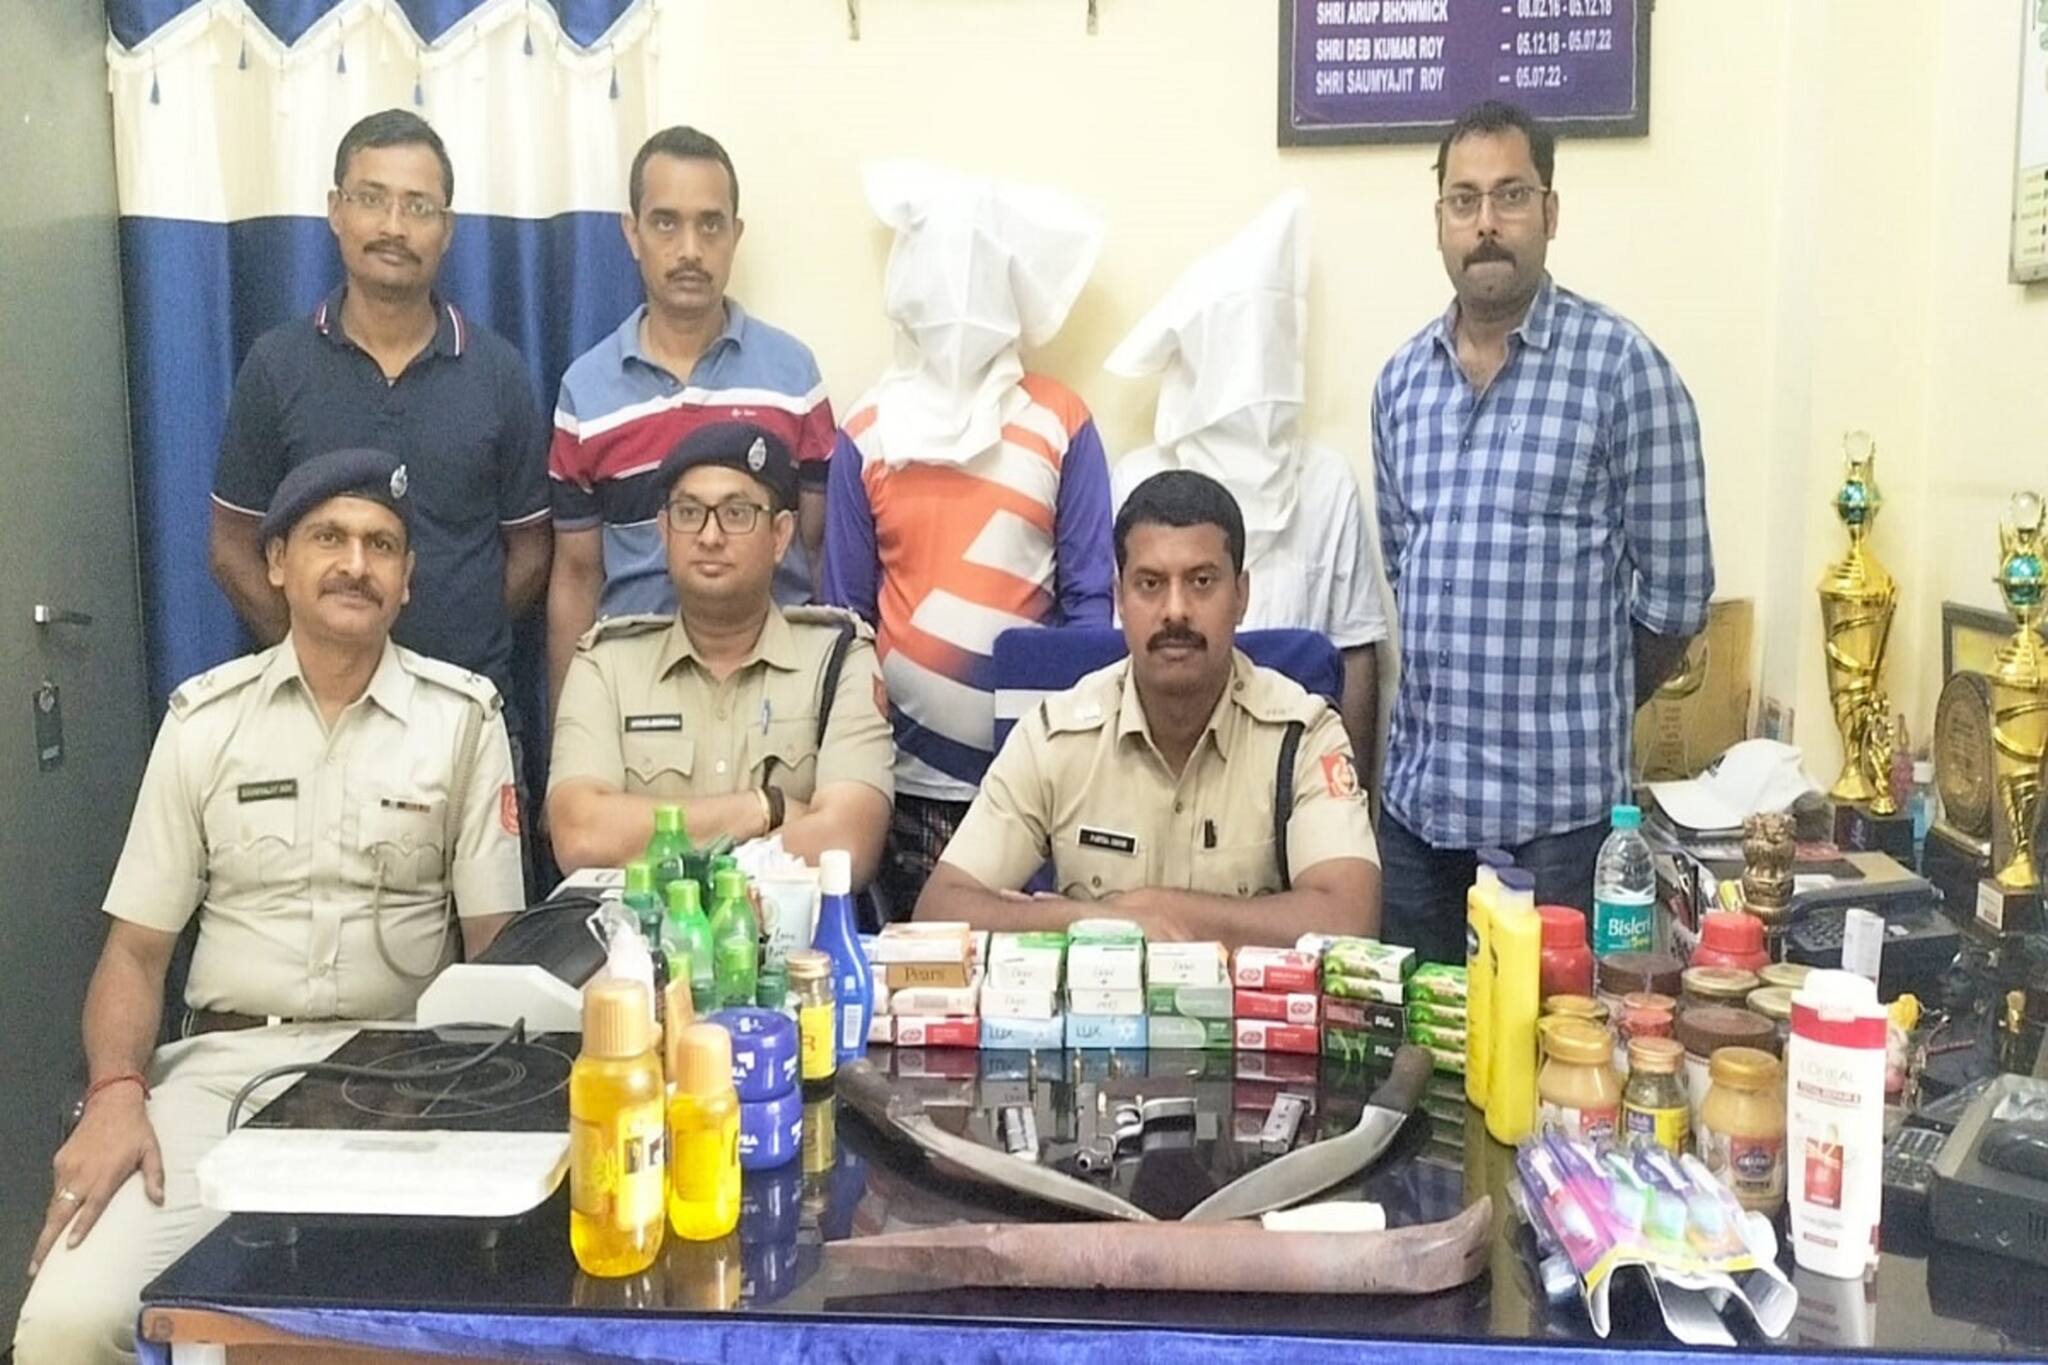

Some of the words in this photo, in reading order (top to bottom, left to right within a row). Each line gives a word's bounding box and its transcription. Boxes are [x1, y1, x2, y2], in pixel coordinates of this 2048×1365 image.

[1316, 1, 1345, 25] SHRI
[1346, 1, 1380, 24] ARUP
[1382, 0, 1448, 23] BHOWMICK
[1316, 38, 1345, 61] SHRI
[1346, 37, 1371, 61] DEB
[1373, 37, 1417, 60] KUMAR
[1419, 35, 1445, 59] ROY
[1517, 31, 1560, 55] 05.12.18
[1568, 28, 1612, 52] 05.07.22
[1316, 69, 1344, 95] SHRI
[1347, 67, 1414, 94] SAUMYAJIT
[1420, 66, 1445, 91] ROY
[1516, 65, 1561, 88] 05.07.22
